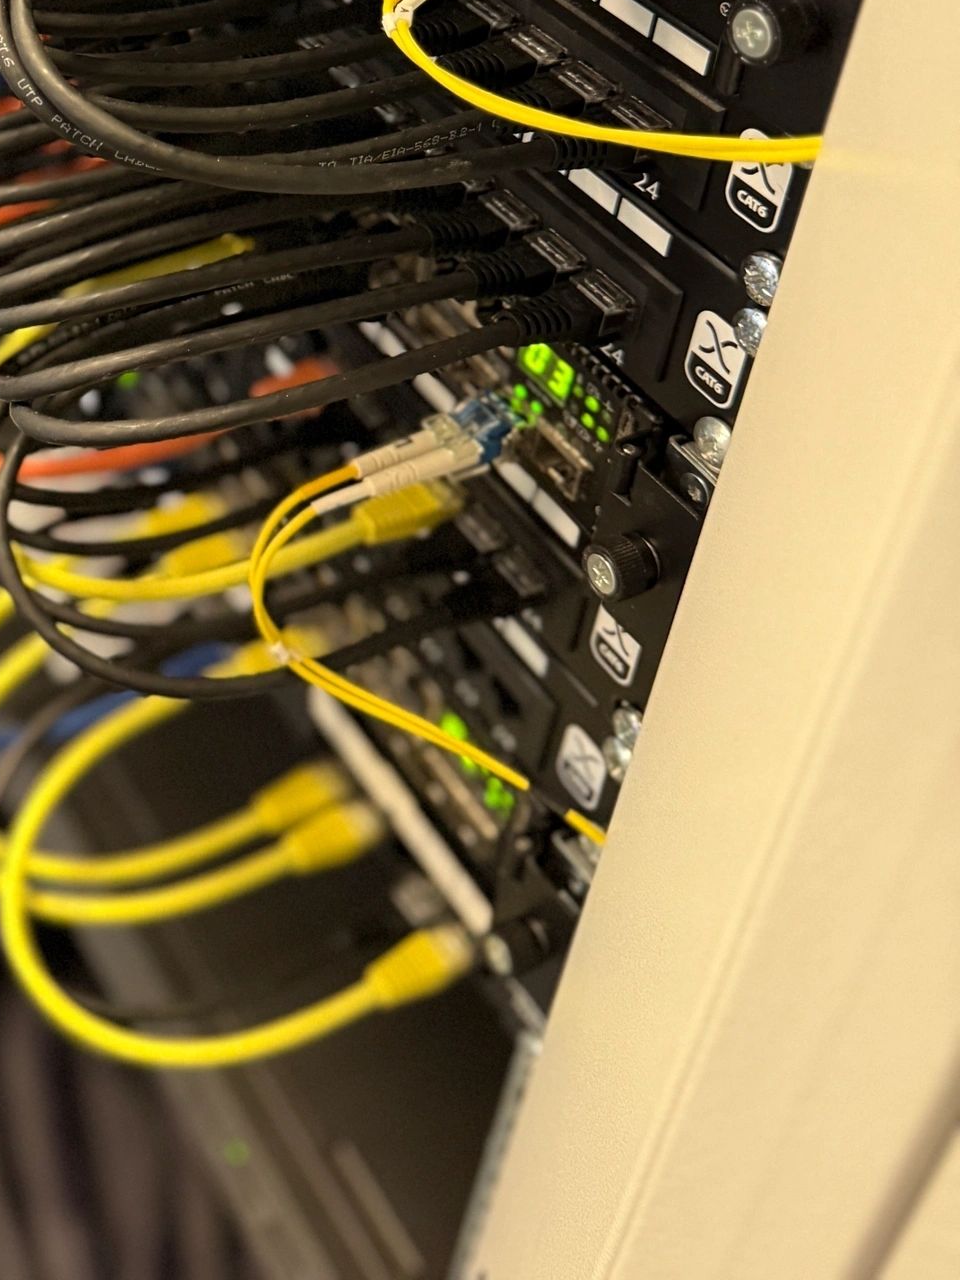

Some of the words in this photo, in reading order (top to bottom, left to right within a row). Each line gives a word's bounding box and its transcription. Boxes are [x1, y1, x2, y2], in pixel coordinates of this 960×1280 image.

[17, 78, 44, 107] UTP
[50, 113, 104, 152] PATCH
[633, 172, 660, 201] 24
[736, 189, 768, 218] CAT6
[695, 365, 725, 395] CAT6
